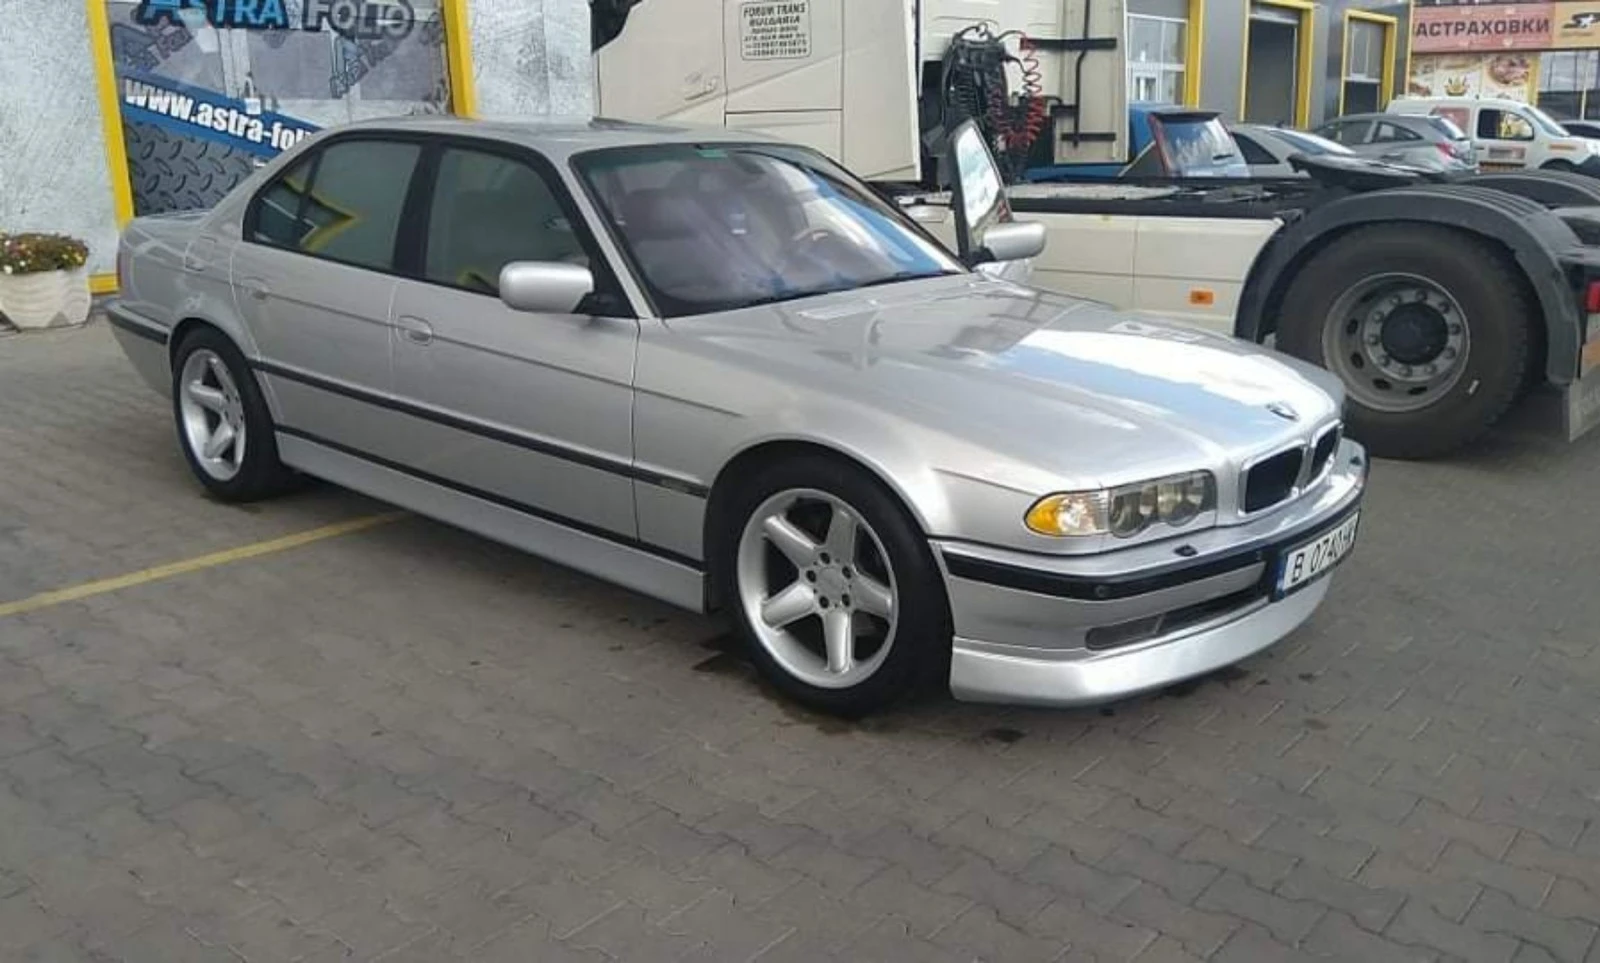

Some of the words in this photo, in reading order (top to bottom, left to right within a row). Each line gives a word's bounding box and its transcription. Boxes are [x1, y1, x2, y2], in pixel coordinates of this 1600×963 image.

[777, 3, 805, 14] TRANS
[1413, 17, 1549, 38] АСТРАХОВКИ
[126, 79, 311, 151] www.astra-fol
[1291, 553, 1305, 583] B
